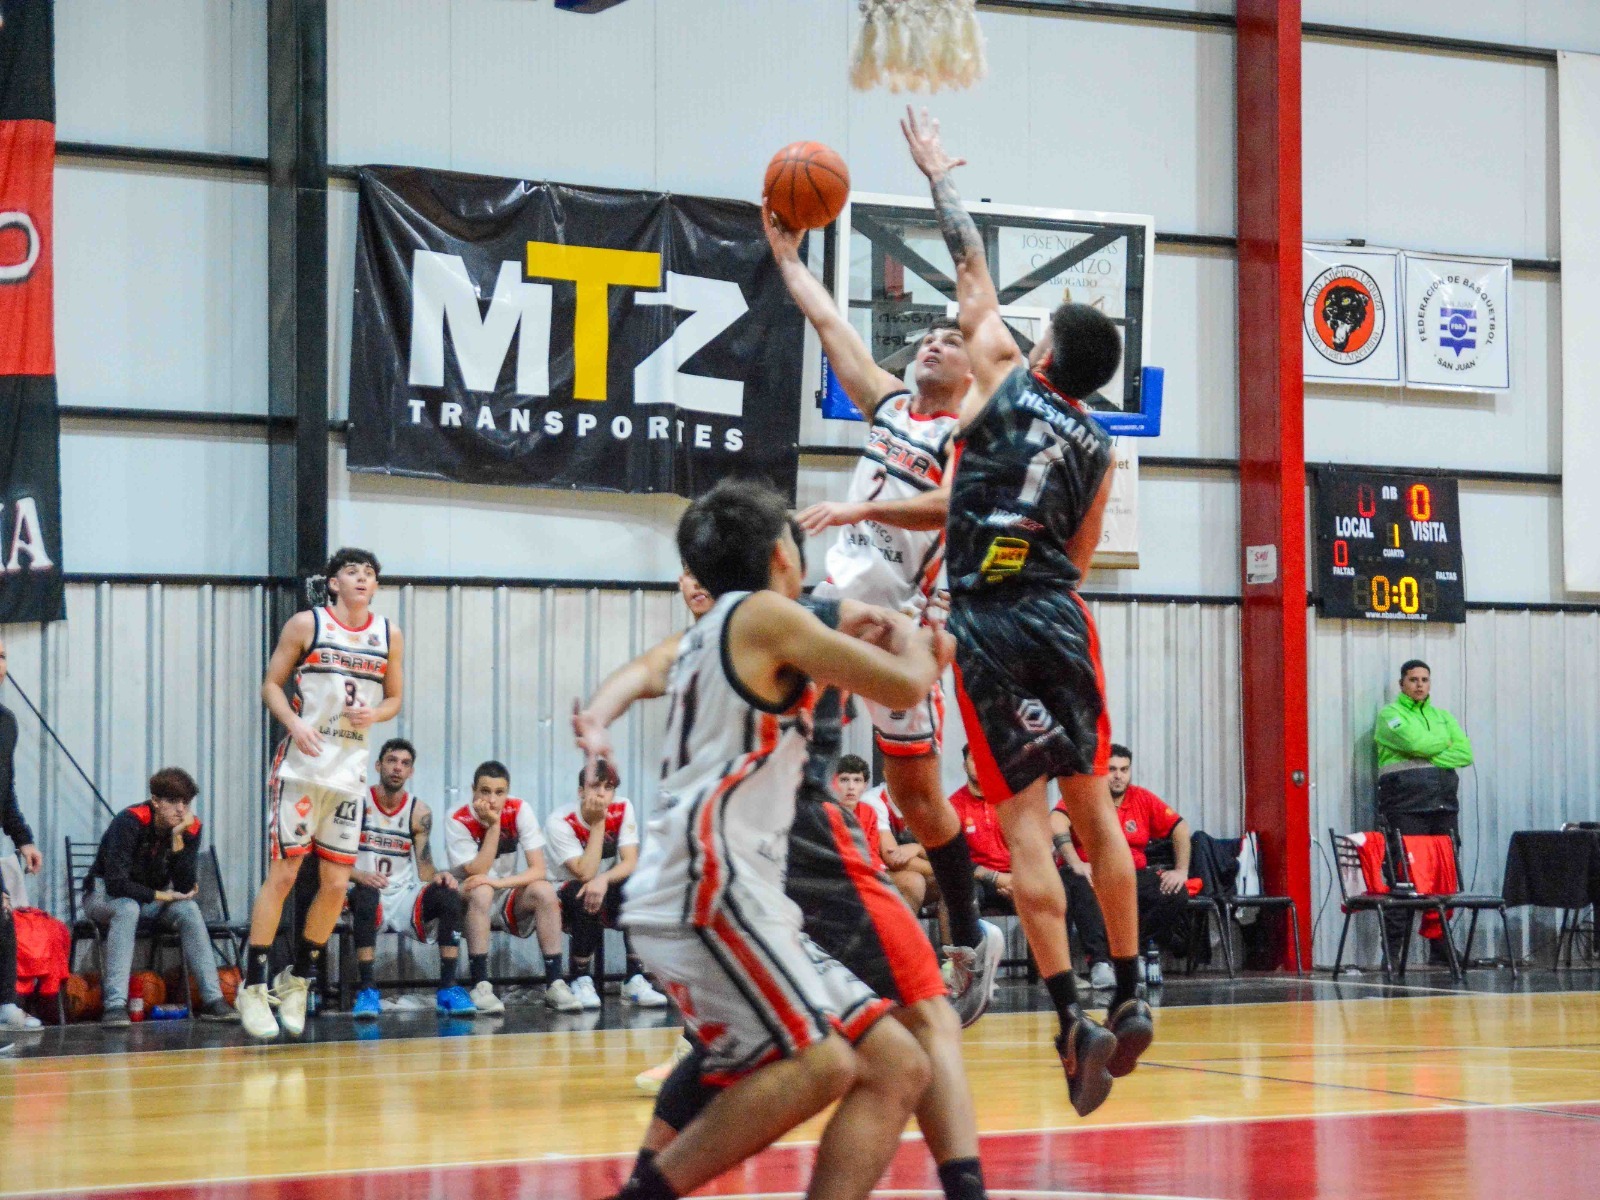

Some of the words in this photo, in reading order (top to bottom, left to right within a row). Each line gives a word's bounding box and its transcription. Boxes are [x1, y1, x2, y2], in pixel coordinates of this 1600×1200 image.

[1306, 282, 1323, 307] Club
[1360, 273, 1382, 311] Urquiza
[1447, 275, 1460, 284] DE
[1462, 278, 1496, 346] BASQUETBOL
[408, 240, 749, 416] MTZ
[1437, 357, 1453, 370] SAN
[1455, 360, 1476, 371] JUAN
[408, 400, 744, 451] TRANSPORTES
[1410, 483, 1432, 522] 0
[1335, 516, 1375, 539] LOCAL
[1393, 523, 1400, 548] 1
[1410, 520, 1448, 543] VISITA
[1334, 539, 1349, 567] 0
[1383, 548, 1405, 558] CUARTO
[1333, 566, 1355, 576] FALTAS
[1435, 571, 1458, 581] FALTAS
